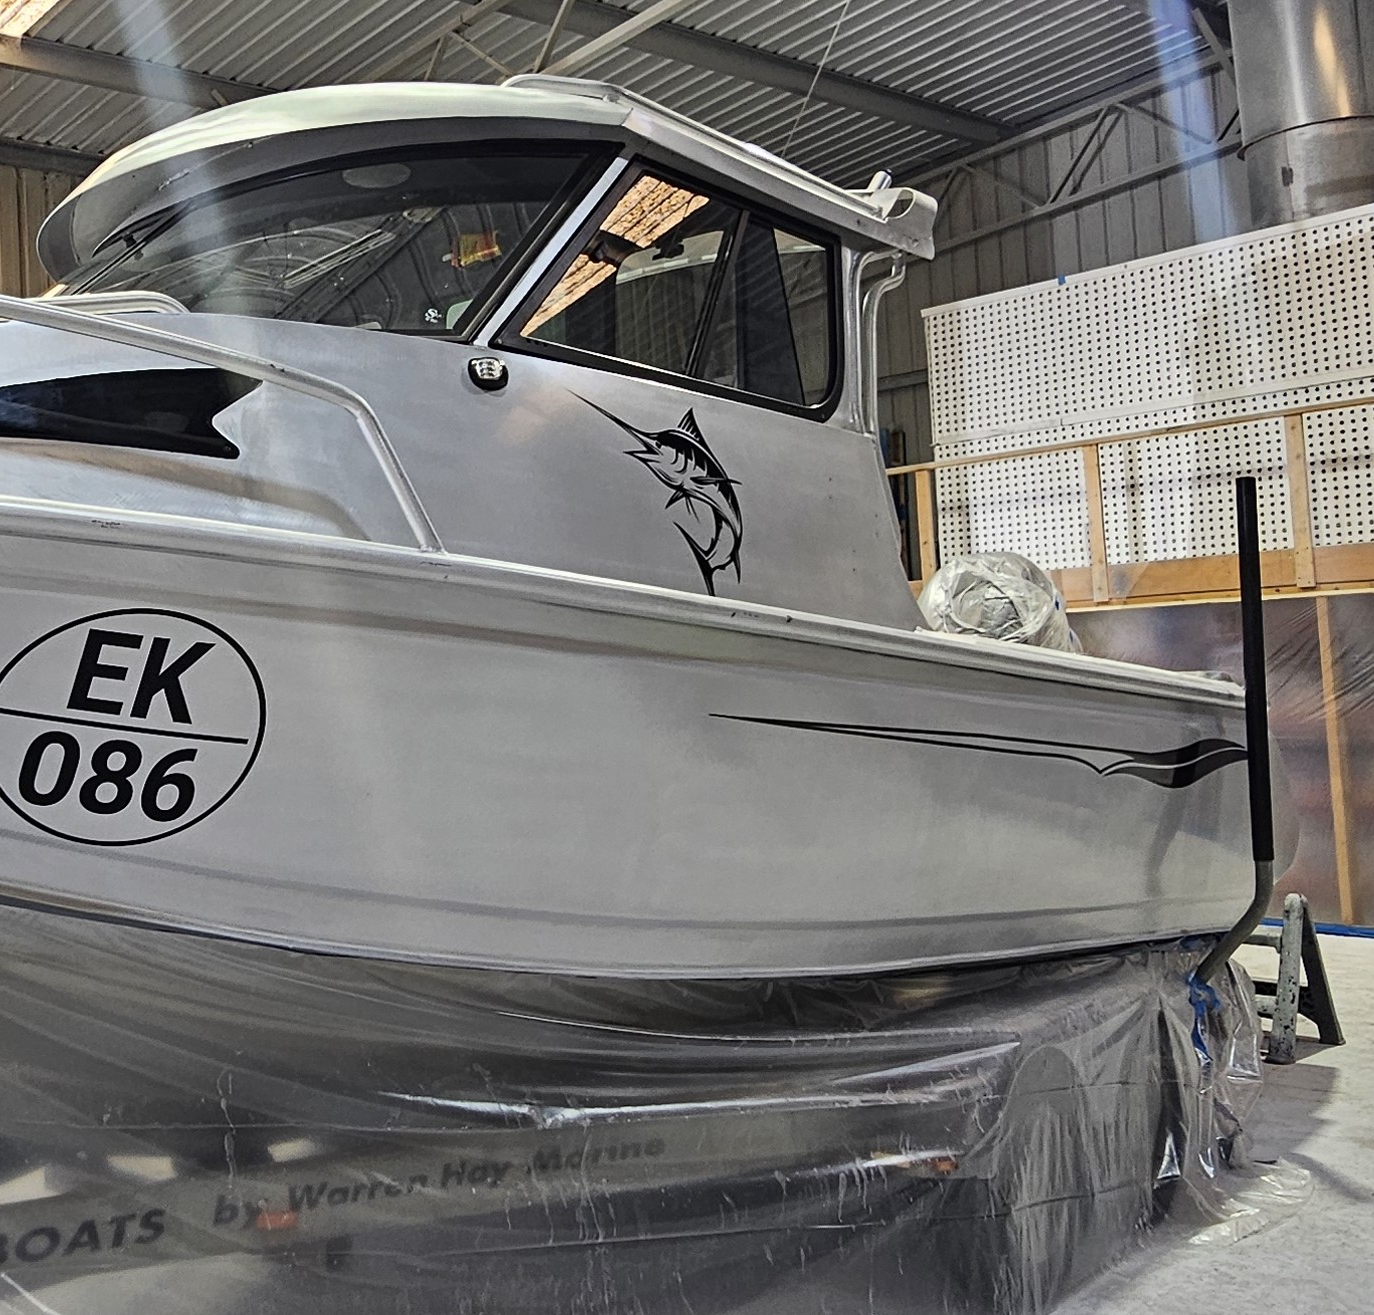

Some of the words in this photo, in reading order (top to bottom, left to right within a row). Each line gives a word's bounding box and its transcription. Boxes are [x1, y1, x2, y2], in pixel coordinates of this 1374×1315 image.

[66, 628, 217, 725] EK
[18, 730, 198, 822] 086
[440, 1158, 512, 1189] Hay
